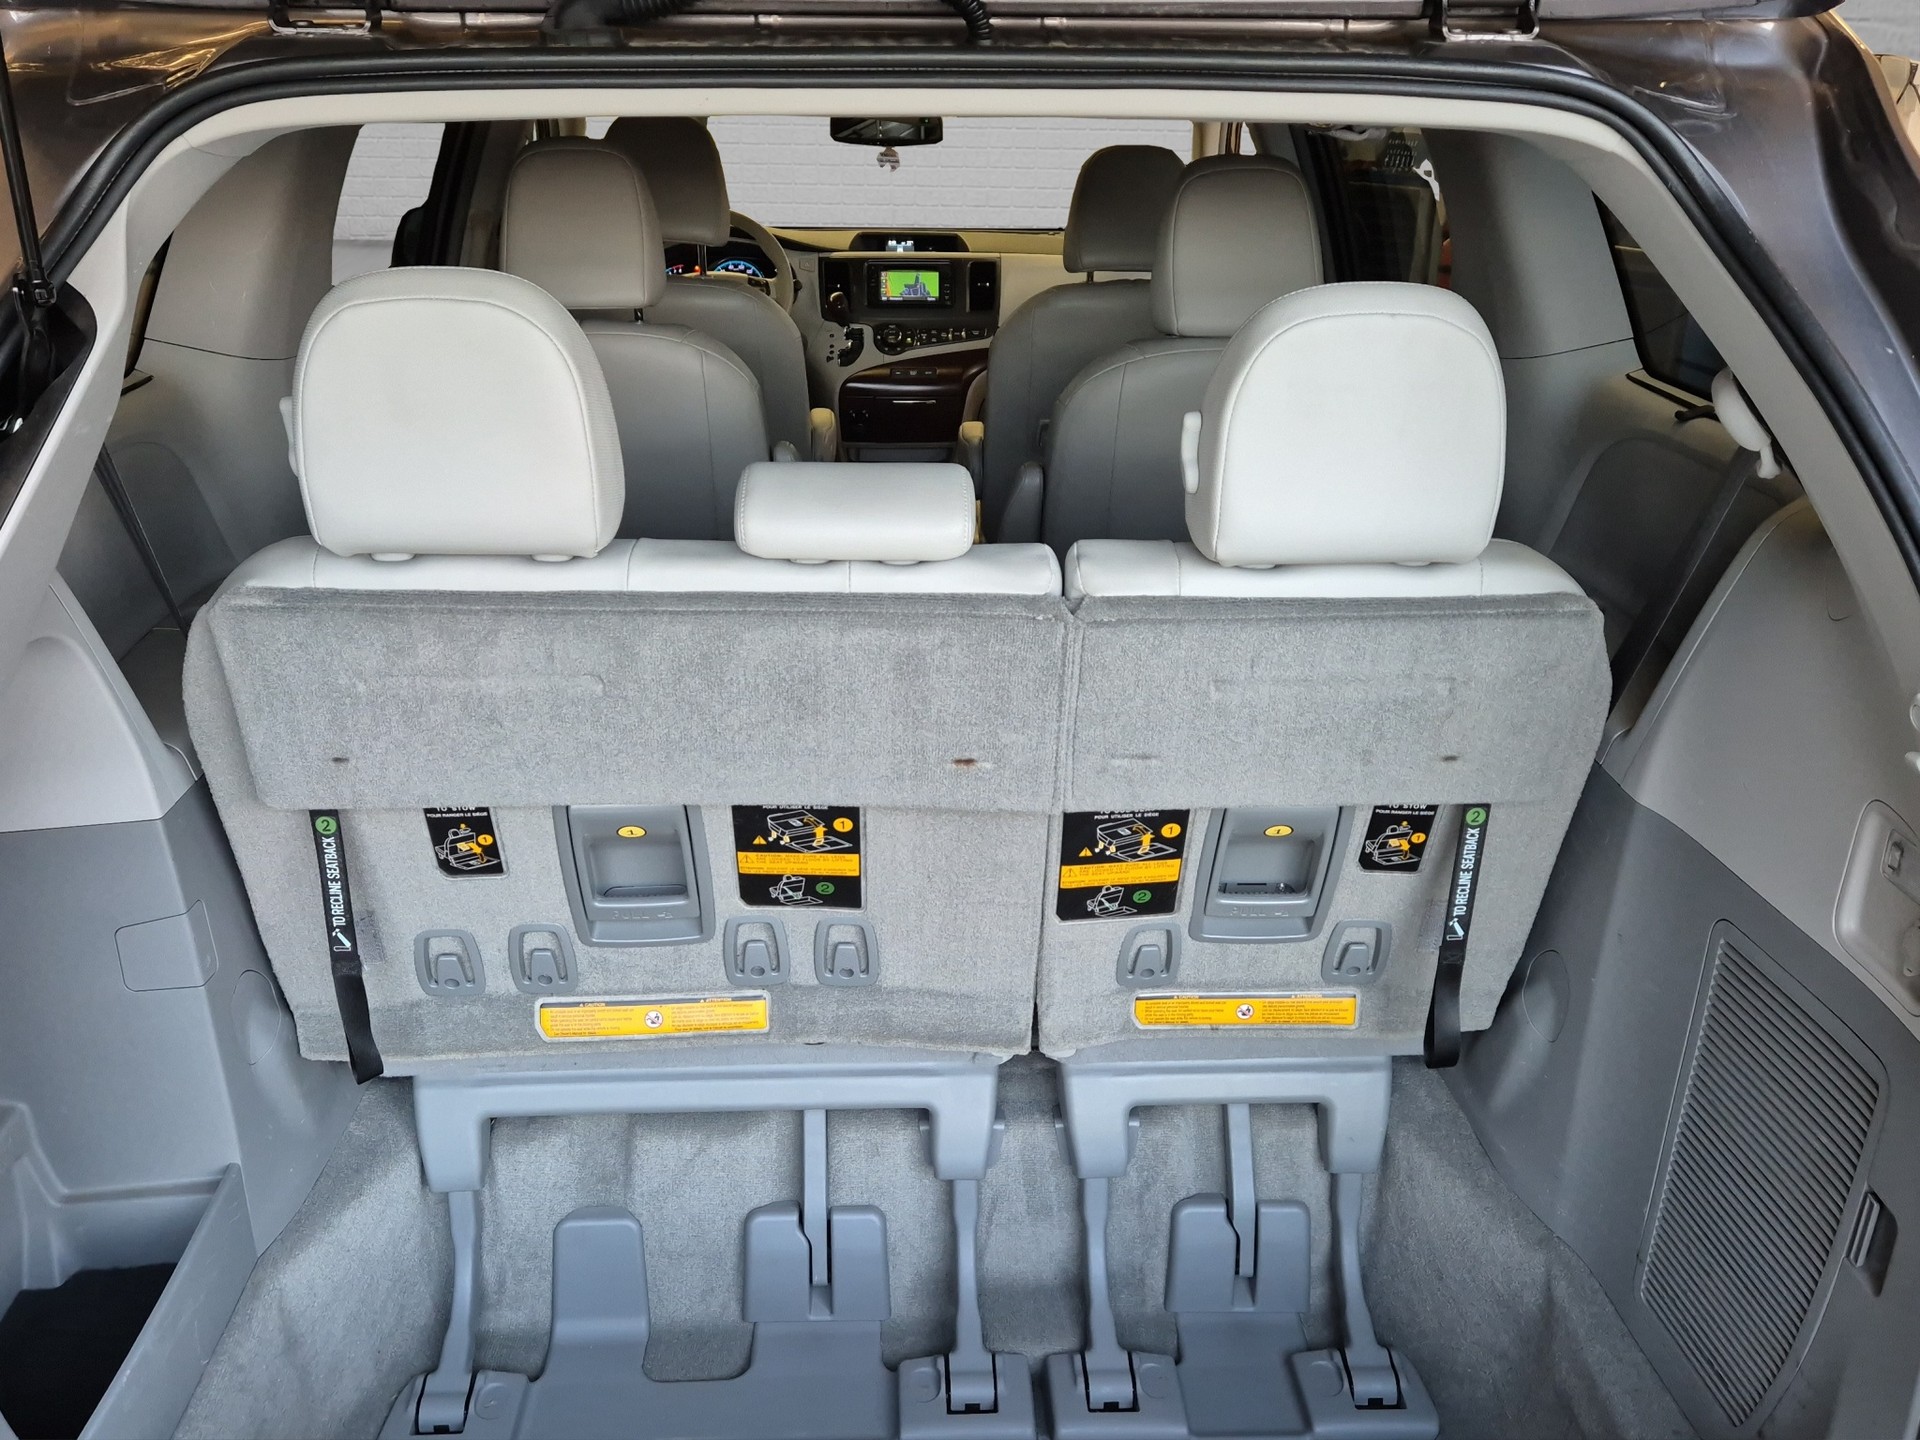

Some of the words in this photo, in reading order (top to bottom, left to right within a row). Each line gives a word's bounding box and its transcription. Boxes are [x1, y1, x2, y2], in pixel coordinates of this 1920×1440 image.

[1470, 811, 1481, 823] 2
[320, 819, 332, 832] 2
[1460, 827, 1480, 870] SEATBACK
[321, 836, 341, 879] SEATBACK
[820, 884, 830, 892] 2
[1455, 870, 1473, 905] RECLINE
[327, 880, 345, 915] RECLINE
[1137, 892, 1147, 901] 2
[1453, 905, 1467, 916] TO
[332, 916, 346, 926] TO
